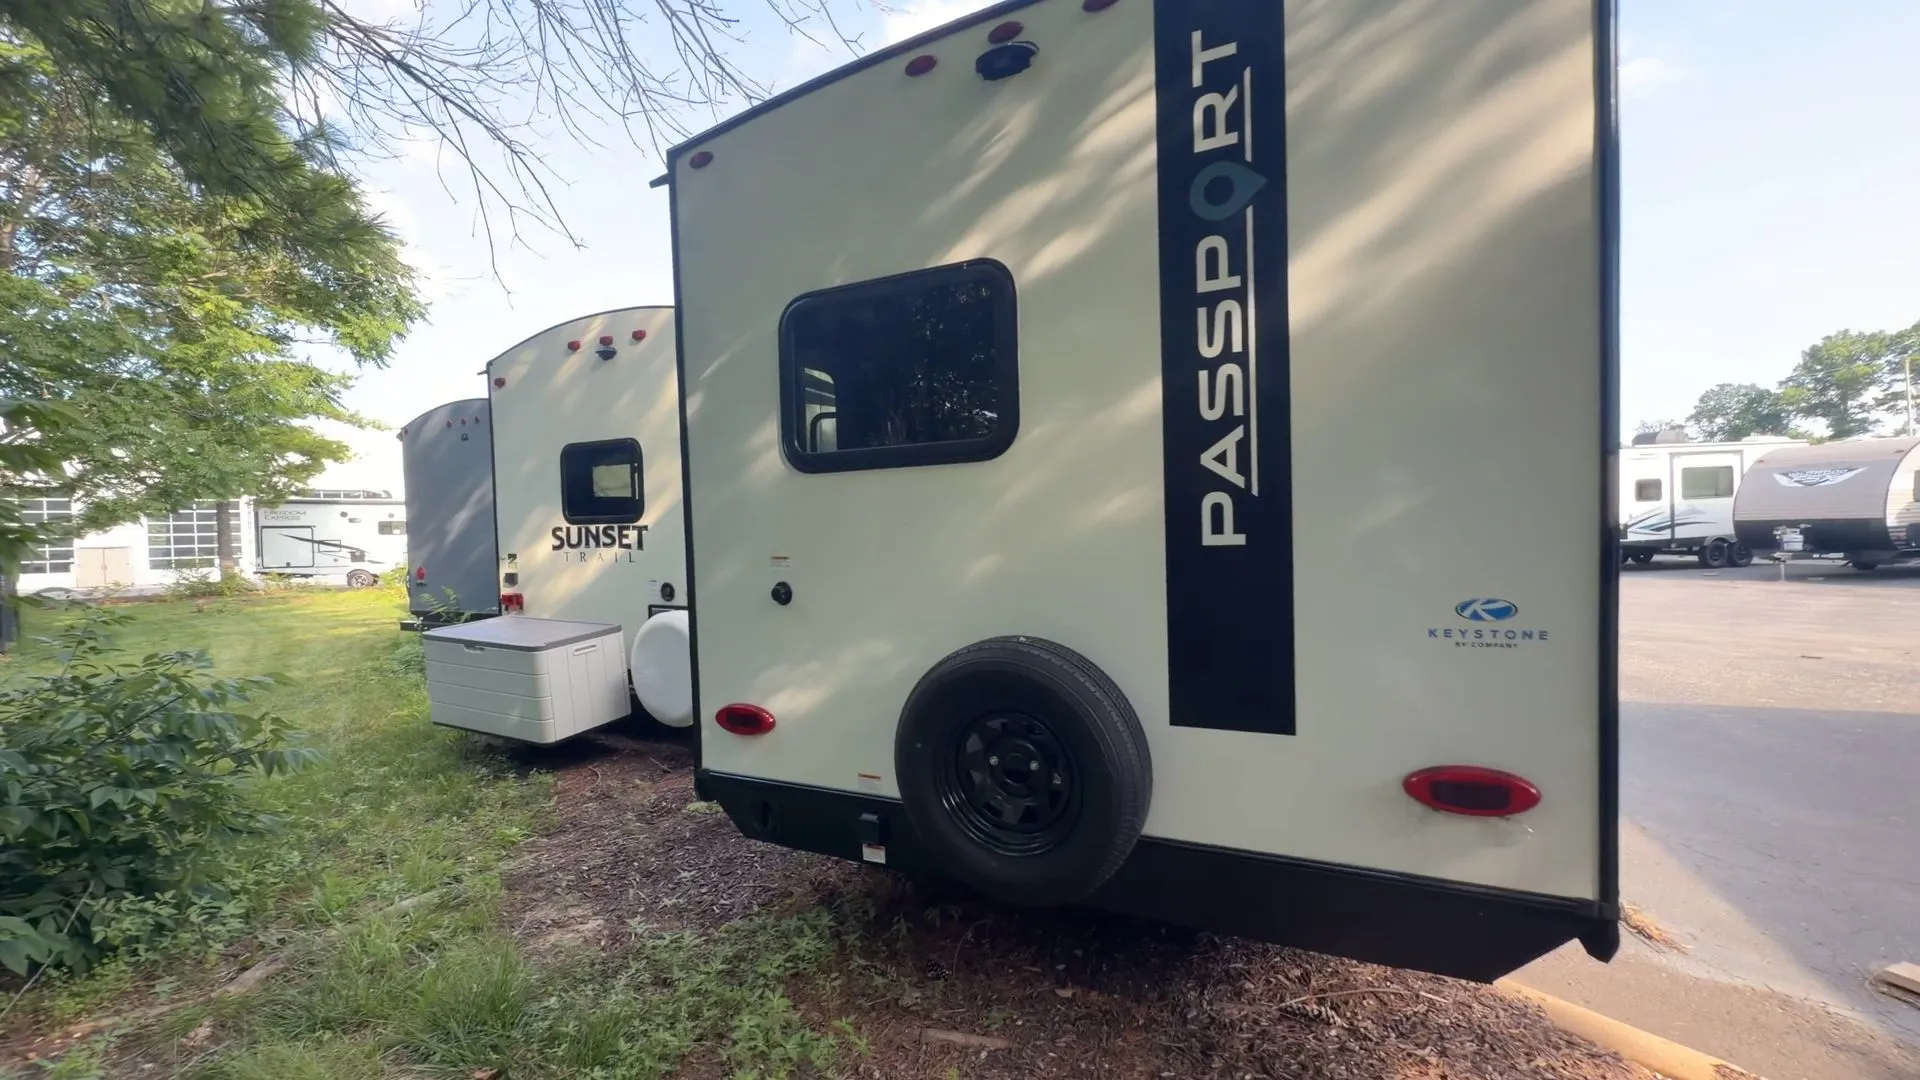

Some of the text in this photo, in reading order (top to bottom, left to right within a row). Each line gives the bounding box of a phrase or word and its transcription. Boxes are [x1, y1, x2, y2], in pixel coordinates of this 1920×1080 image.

[1190, 30, 1257, 546] PASSPORT
[552, 525, 648, 551] SUNSET
[564, 551, 635, 563] TRAIL
[1428, 628, 1549, 641] KEYSTONE
[1471, 641, 1518, 649] COMPANY
